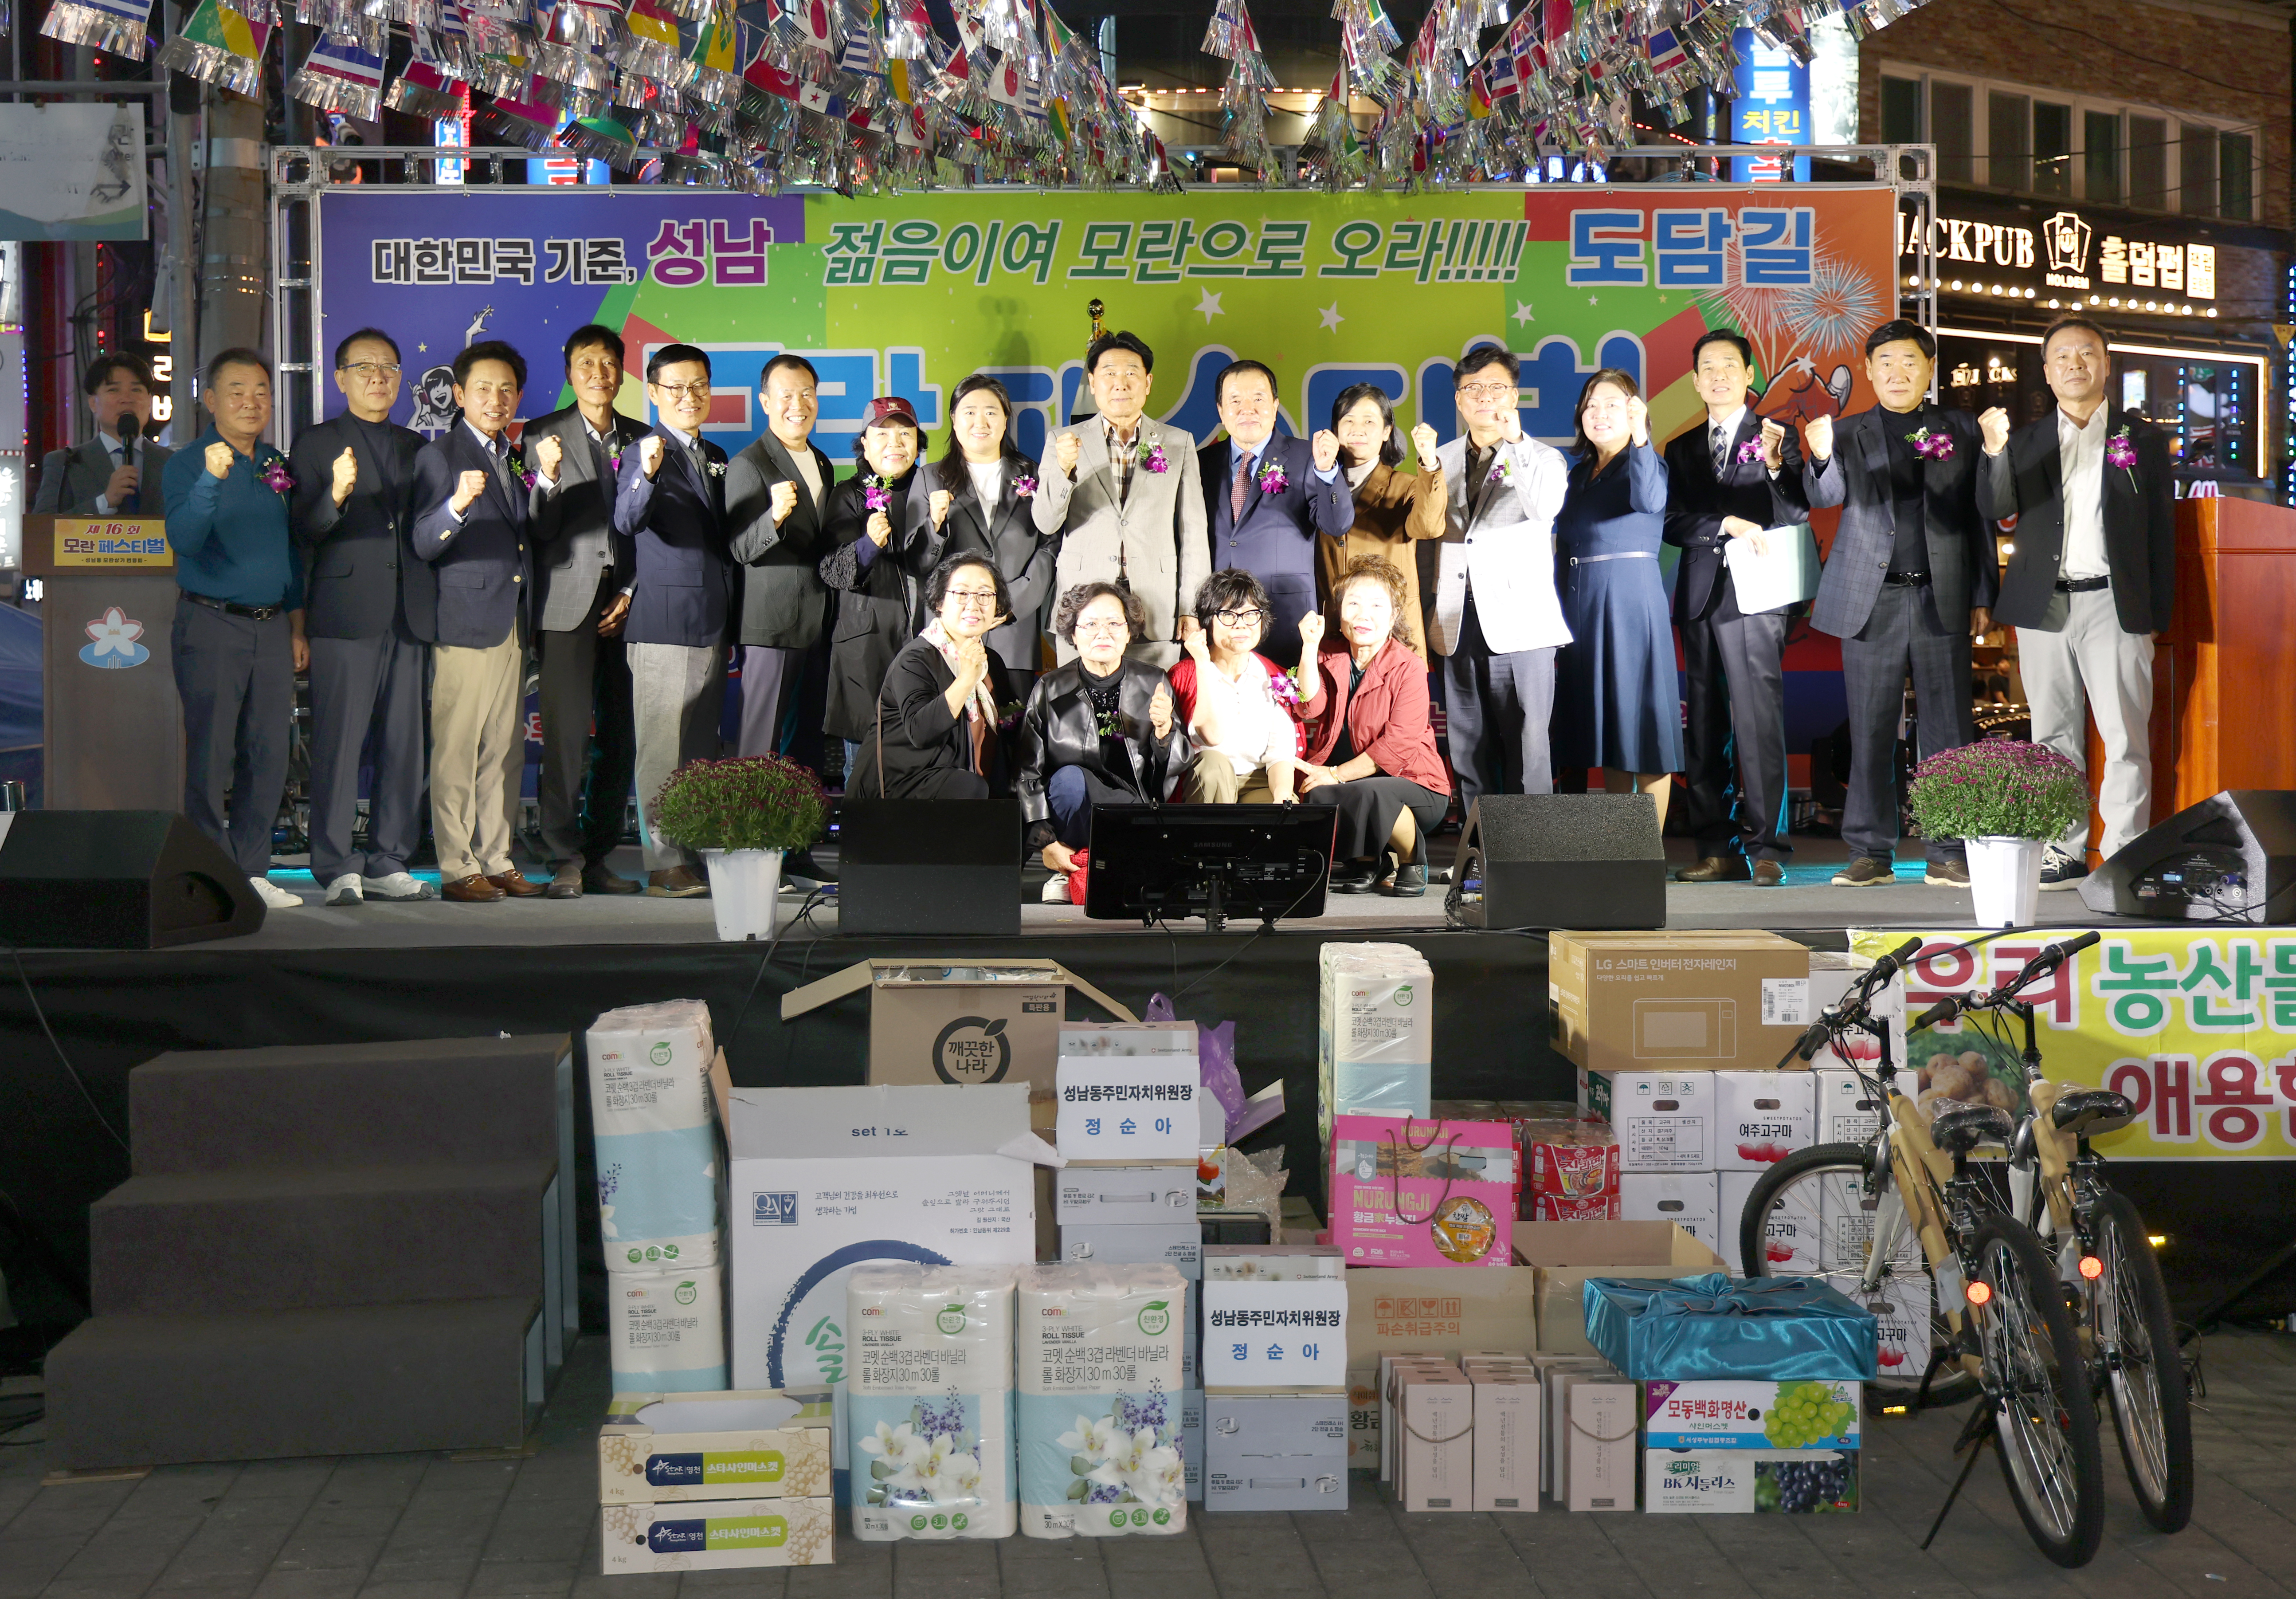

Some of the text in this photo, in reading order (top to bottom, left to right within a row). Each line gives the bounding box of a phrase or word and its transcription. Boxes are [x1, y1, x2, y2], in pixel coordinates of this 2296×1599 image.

[1742, 110, 1800, 134] 치킨
[1897, 211, 2034, 268] JACKPUB
[372, 218, 774, 287] 대한민국 기준, 성남
[822, 218, 1530, 287] 젊음이여 모란으로 오라!!!!!
[1566, 207, 1815, 289] 도담길
[2099, 236, 2184, 290] 홀덤펍
[2046, 273, 2090, 290] HOLDEM
[86, 523, 141, 535] 제 16 회
[63, 538, 165, 554] 모란 페스티벌
[1596, 959, 1612, 970] LG
[1616, 959, 1648, 970] 스마트
[1650, 959, 1681, 970] 인버터
[1683, 959, 1736, 970] 전자레인지
[1352, 1017, 1413, 1028] 코멧 순백 라벤더 바닐라
[948, 1041, 995, 1058] 깨끗한
[956, 1059, 987, 1074] 나라
[605, 1077, 674, 1093] 코멧 순백 라벤더 바닐라
[1064, 1084, 1193, 1101] 성남동주민자치위원장
[2109, 1057, 2296, 1144] 애용
[851, 1126, 876, 1137] set
[1740, 1124, 1792, 1138] 여주고구마
[1560, 1155, 1601, 1174] 진라면
[815, 1190, 898, 1200] 고객님의 건강을 최우선으로
[1353, 1190, 1430, 1211] NURUNGJI
[815, 1206, 857, 1215] 생각하는 기업
[1453, 1212, 1469, 1222] 찹쌀
[629, 1317, 698, 1331] 코멧 순백 라벤더 바닐라
[1211, 1310, 1340, 1327] 성남동주민자치위원장
[1377, 1322, 1460, 1336] 파손취급주의
[1878, 1328, 1907, 1342] 고구마
[862, 1349, 966, 1365] 코멧 순백 3겹 라벤더 바닐라
[1042, 1344, 1169, 1364] 코멧 순백 3겹 라벤더 바닐라
[862, 1367, 871, 1383] 롤
[1042, 1367, 1053, 1383] 롤
[1668, 1399, 1747, 1419] 모동백화명산
[706, 1461, 778, 1473] 스타샤인머스켓
[1665, 1462, 1699, 1471] 프리미엄
[1664, 1476, 1735, 1491] BK 시들리스
[616, 1488, 624, 1496] kg
[709, 1526, 780, 1539] 스타샤인머스켓
